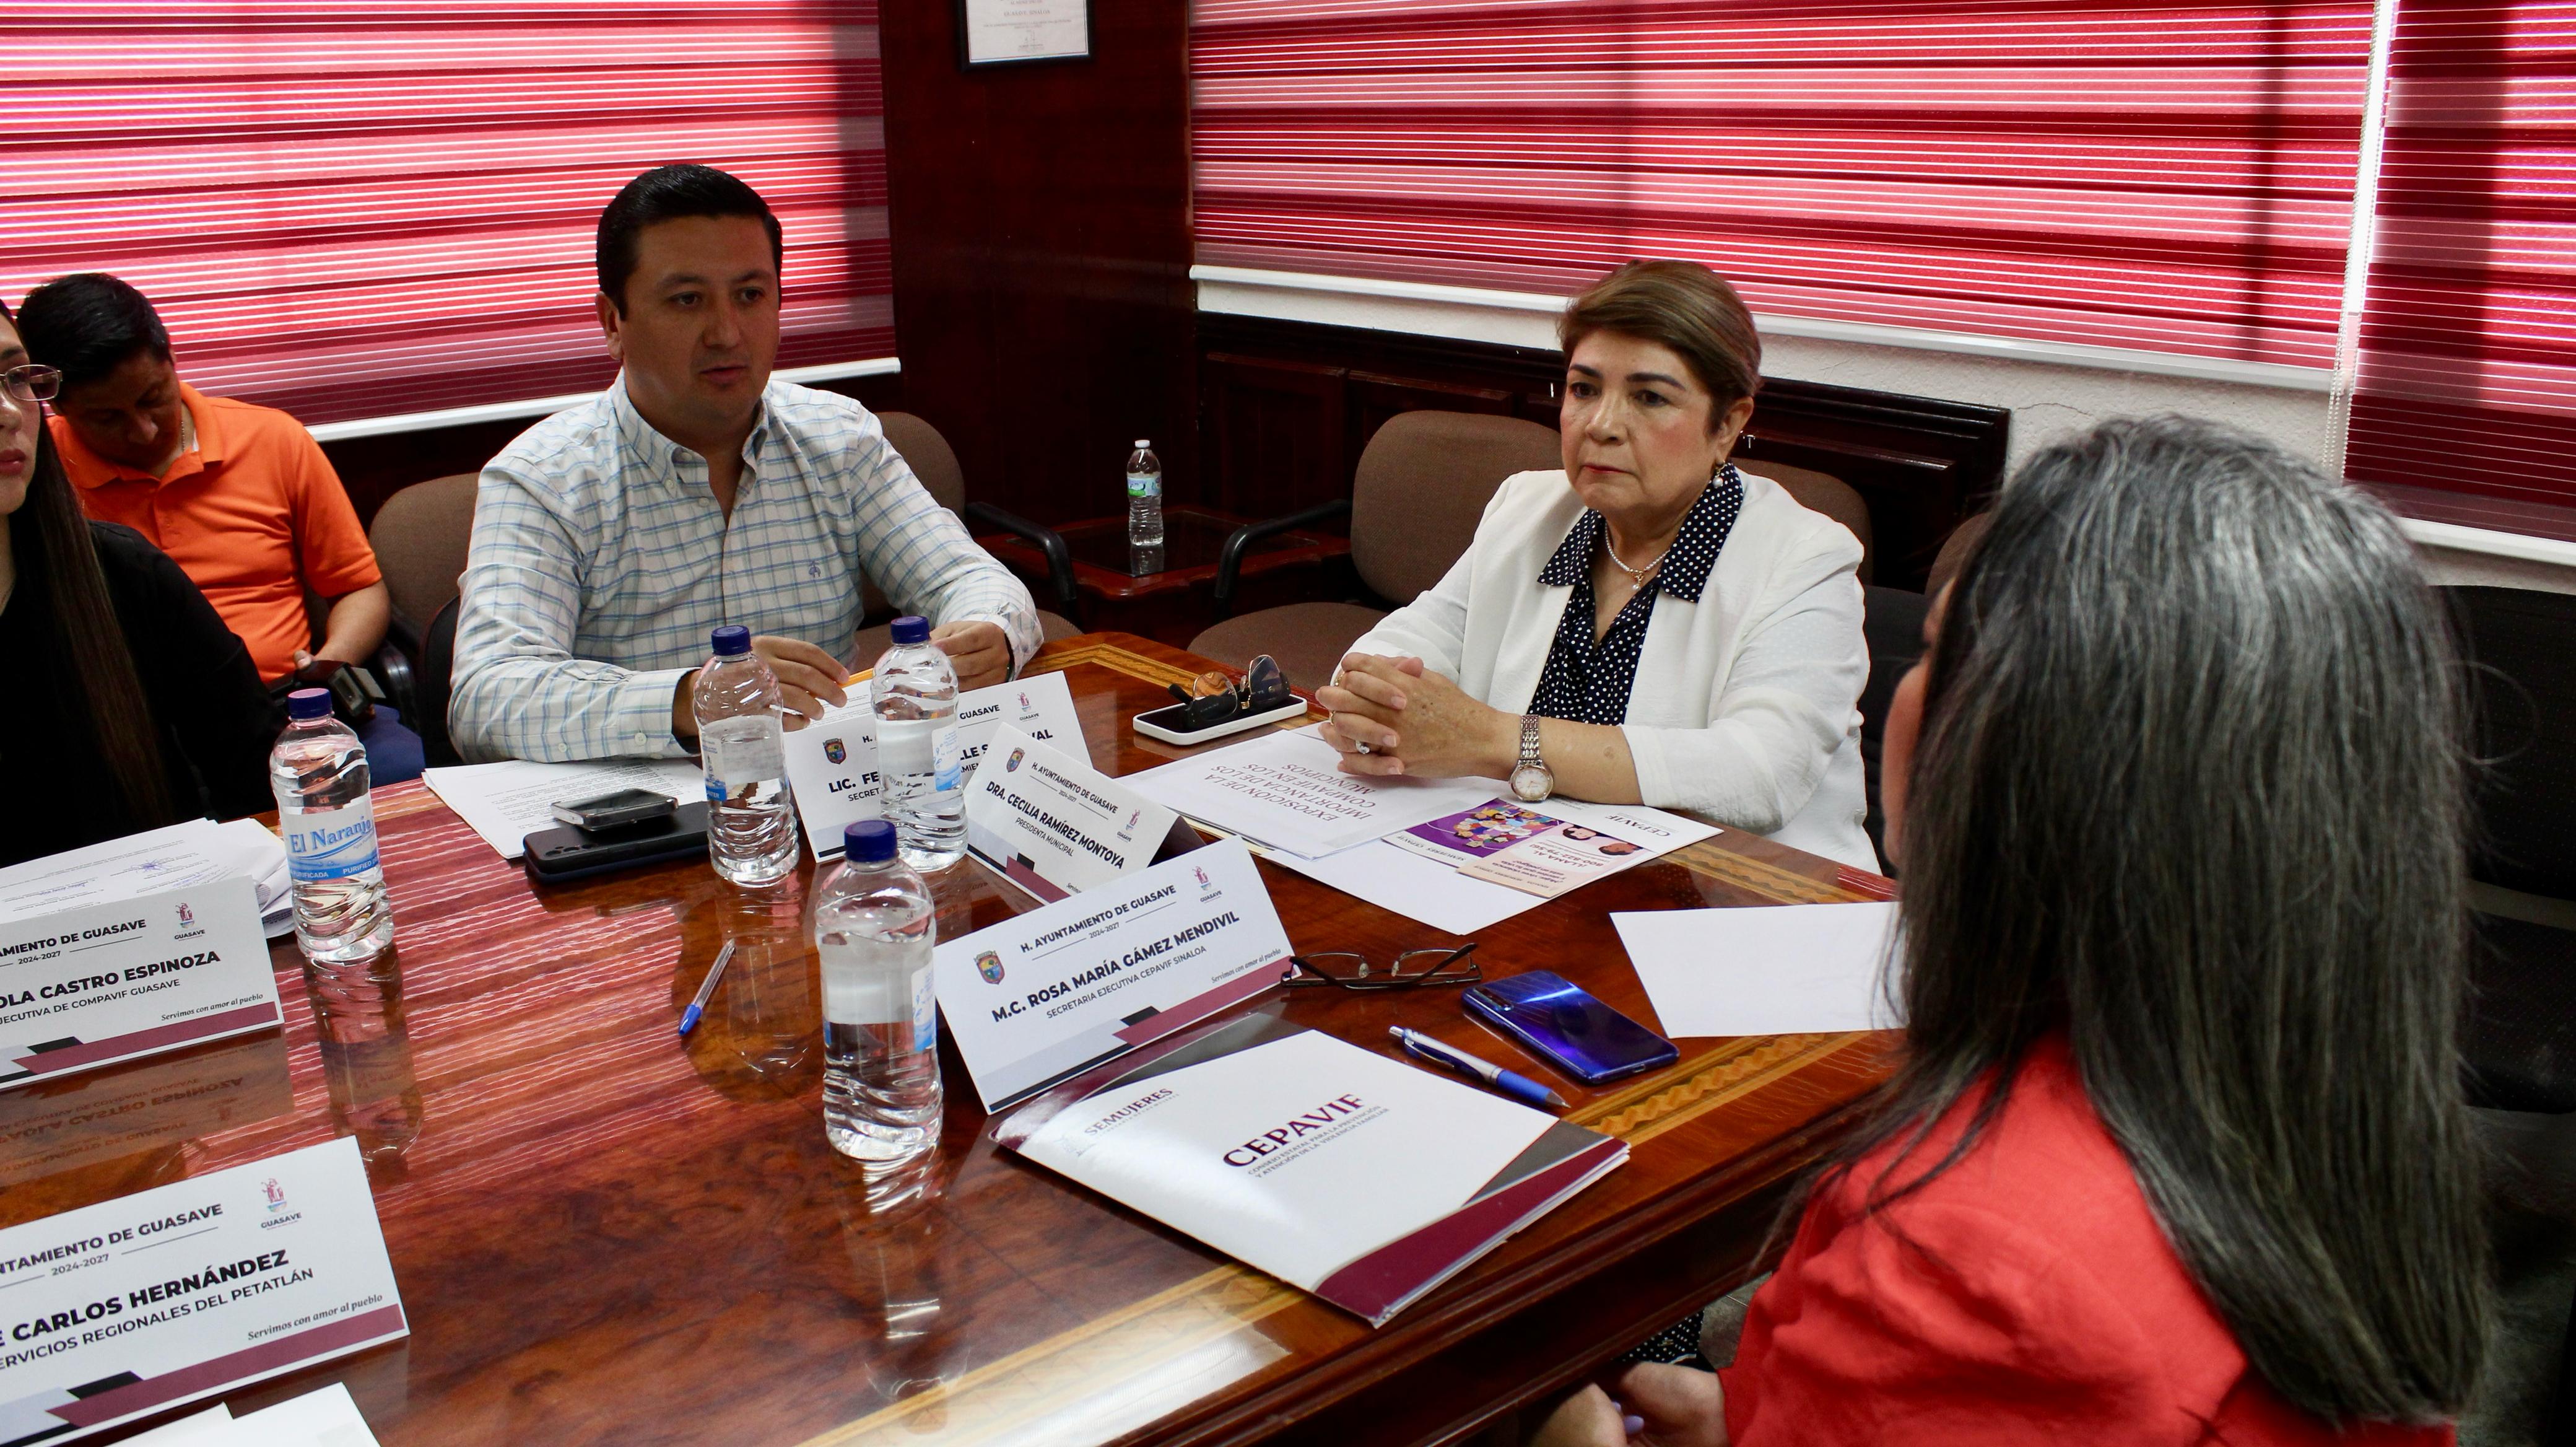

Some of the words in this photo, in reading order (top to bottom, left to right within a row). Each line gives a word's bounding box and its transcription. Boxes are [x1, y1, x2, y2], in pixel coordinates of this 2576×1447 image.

[862, 735, 872, 743] H.
[959, 704, 1000, 720] GUASAVE
[1019, 713, 1039, 721] GUASAVE
[829, 778, 856, 793] LIC.
[960, 746, 980, 761] LE
[848, 787, 879, 802] SECRET
[961, 763, 978, 773] MIE
[1203, 774, 1224, 784] LA
[1211, 765, 1243, 777] LOS
[1221, 780, 1246, 791] DE
[1242, 763, 1275, 775] LOS
[1242, 774, 1265, 784] DE
[1272, 772, 1295, 782] EN
[1281, 763, 1375, 795] MUNICIPIOS
[1032, 762, 1038, 771] H.
[1038, 766, 1081, 793] AYUNTAMIENTO
[1081, 789, 1090, 799] DE
[1089, 794, 1118, 813] GUASAVE
[1058, 790, 1077, 802] 2024-2027
[1243, 787, 1339, 821] EXPOSICIÓN
[1263, 781, 1373, 820] IMPORTANCIA
[1293, 780, 1375, 808] COMPAVIF
[290, 834, 307, 853] El
[310, 815, 372, 850] Naranjo
[986, 780, 1006, 800] DRA.
[1007, 793, 1039, 820] CECILIA
[1039, 812, 1081, 842] RAMÍREZ
[1078, 834, 1125, 870] MONTOYA
[1016, 817, 1046, 840] PRESIDENTA
[1045, 836, 1074, 857] MUNICIPAL
[1116, 831, 1132, 842] GUASAVE
[1605, 813, 1671, 837] CEPAVIF
[343, 861, 372, 874] PURIFIED
[1200, 890, 1222, 903] GUASAVE
[61, 933, 80, 944] DE
[82, 919, 146, 939] GUASAVE
[174, 929, 205, 940] GUASAVE
[1020, 942, 1033, 953] H.
[1035, 911, 1113, 948] AYUNTAMIENTO
[1114, 904, 1129, 916] DE
[1130, 885, 1176, 909] GUASAVE
[1089, 922, 1120, 939] 2024-2027
[18, 950, 61, 964] 2024-2027
[991, 1001, 1027, 1023] M.C.
[1027, 981, 1071, 1008] ROSA
[1071, 960, 1122, 989] MARÍA
[1123, 938, 1173, 967] GÁMEZ
[1173, 911, 1240, 946] MENDIVIL
[1211, 967, 1235, 984] Servimos
[1235, 964, 1245, 973] con
[1244, 957, 1259, 969] amor
[1258, 954, 1265, 964] al
[1264, 948, 1281, 961] pueblo
[40, 973, 119, 999] CASTRO
[124, 951, 220, 981] ESPINOZA
[1046, 992, 1097, 1018] SECRETARIA
[1097, 974, 1140, 997] EJECUTIVA
[1140, 958, 1173, 978] CEPAVIF
[1173, 945, 1207, 965] SINALOA
[53, 1003, 69, 1013] DE
[71, 990, 128, 1008] COMPAVIF
[131, 979, 180, 996] GUASAVE
[162, 1009, 194, 1021] Servimos
[210, 1000, 230, 1010] amor
[239, 994, 263, 1005] pueblo
[1084, 1088, 1173, 1135] SEMUJERES
[1222, 1093, 1365, 1167] CEPAVIF
[1248, 1155, 1281, 1175] CONSEJO
[1281, 1142, 1310, 1158] ESTATAL
[1309, 1131, 1330, 1143] PARA
[1328, 1125, 1339, 1133] LA
[1338, 1105, 1382, 1127] PREVENCIÓN
[1262, 1153, 1300, 1176] ATENCIÓN
[1300, 1147, 1310, 1156] DE
[1321, 1124, 1358, 1144] VIOLENCIA
[108, 1228, 134, 1244] DE
[138, 1204, 223, 1235] GUASAVE
[261, 1212, 302, 1228] GUASAVE
[51, 1253, 109, 1275] 2024-2027
[12, 1296, 123, 1340] CARLOS
[129, 1249, 289, 1308] HERNÁNDEZ
[82, 1304, 191, 1345] REGIONALES
[195, 1294, 228, 1311] DEL
[231, 1268, 313, 1300] PETATLÁN
[248, 1322, 292, 1340] Servimos
[294, 1315, 310, 1326] con
[313, 1306, 339, 1321] amor
[340, 1303, 350, 1313] al
[351, 1294, 383, 1311] pueblo
